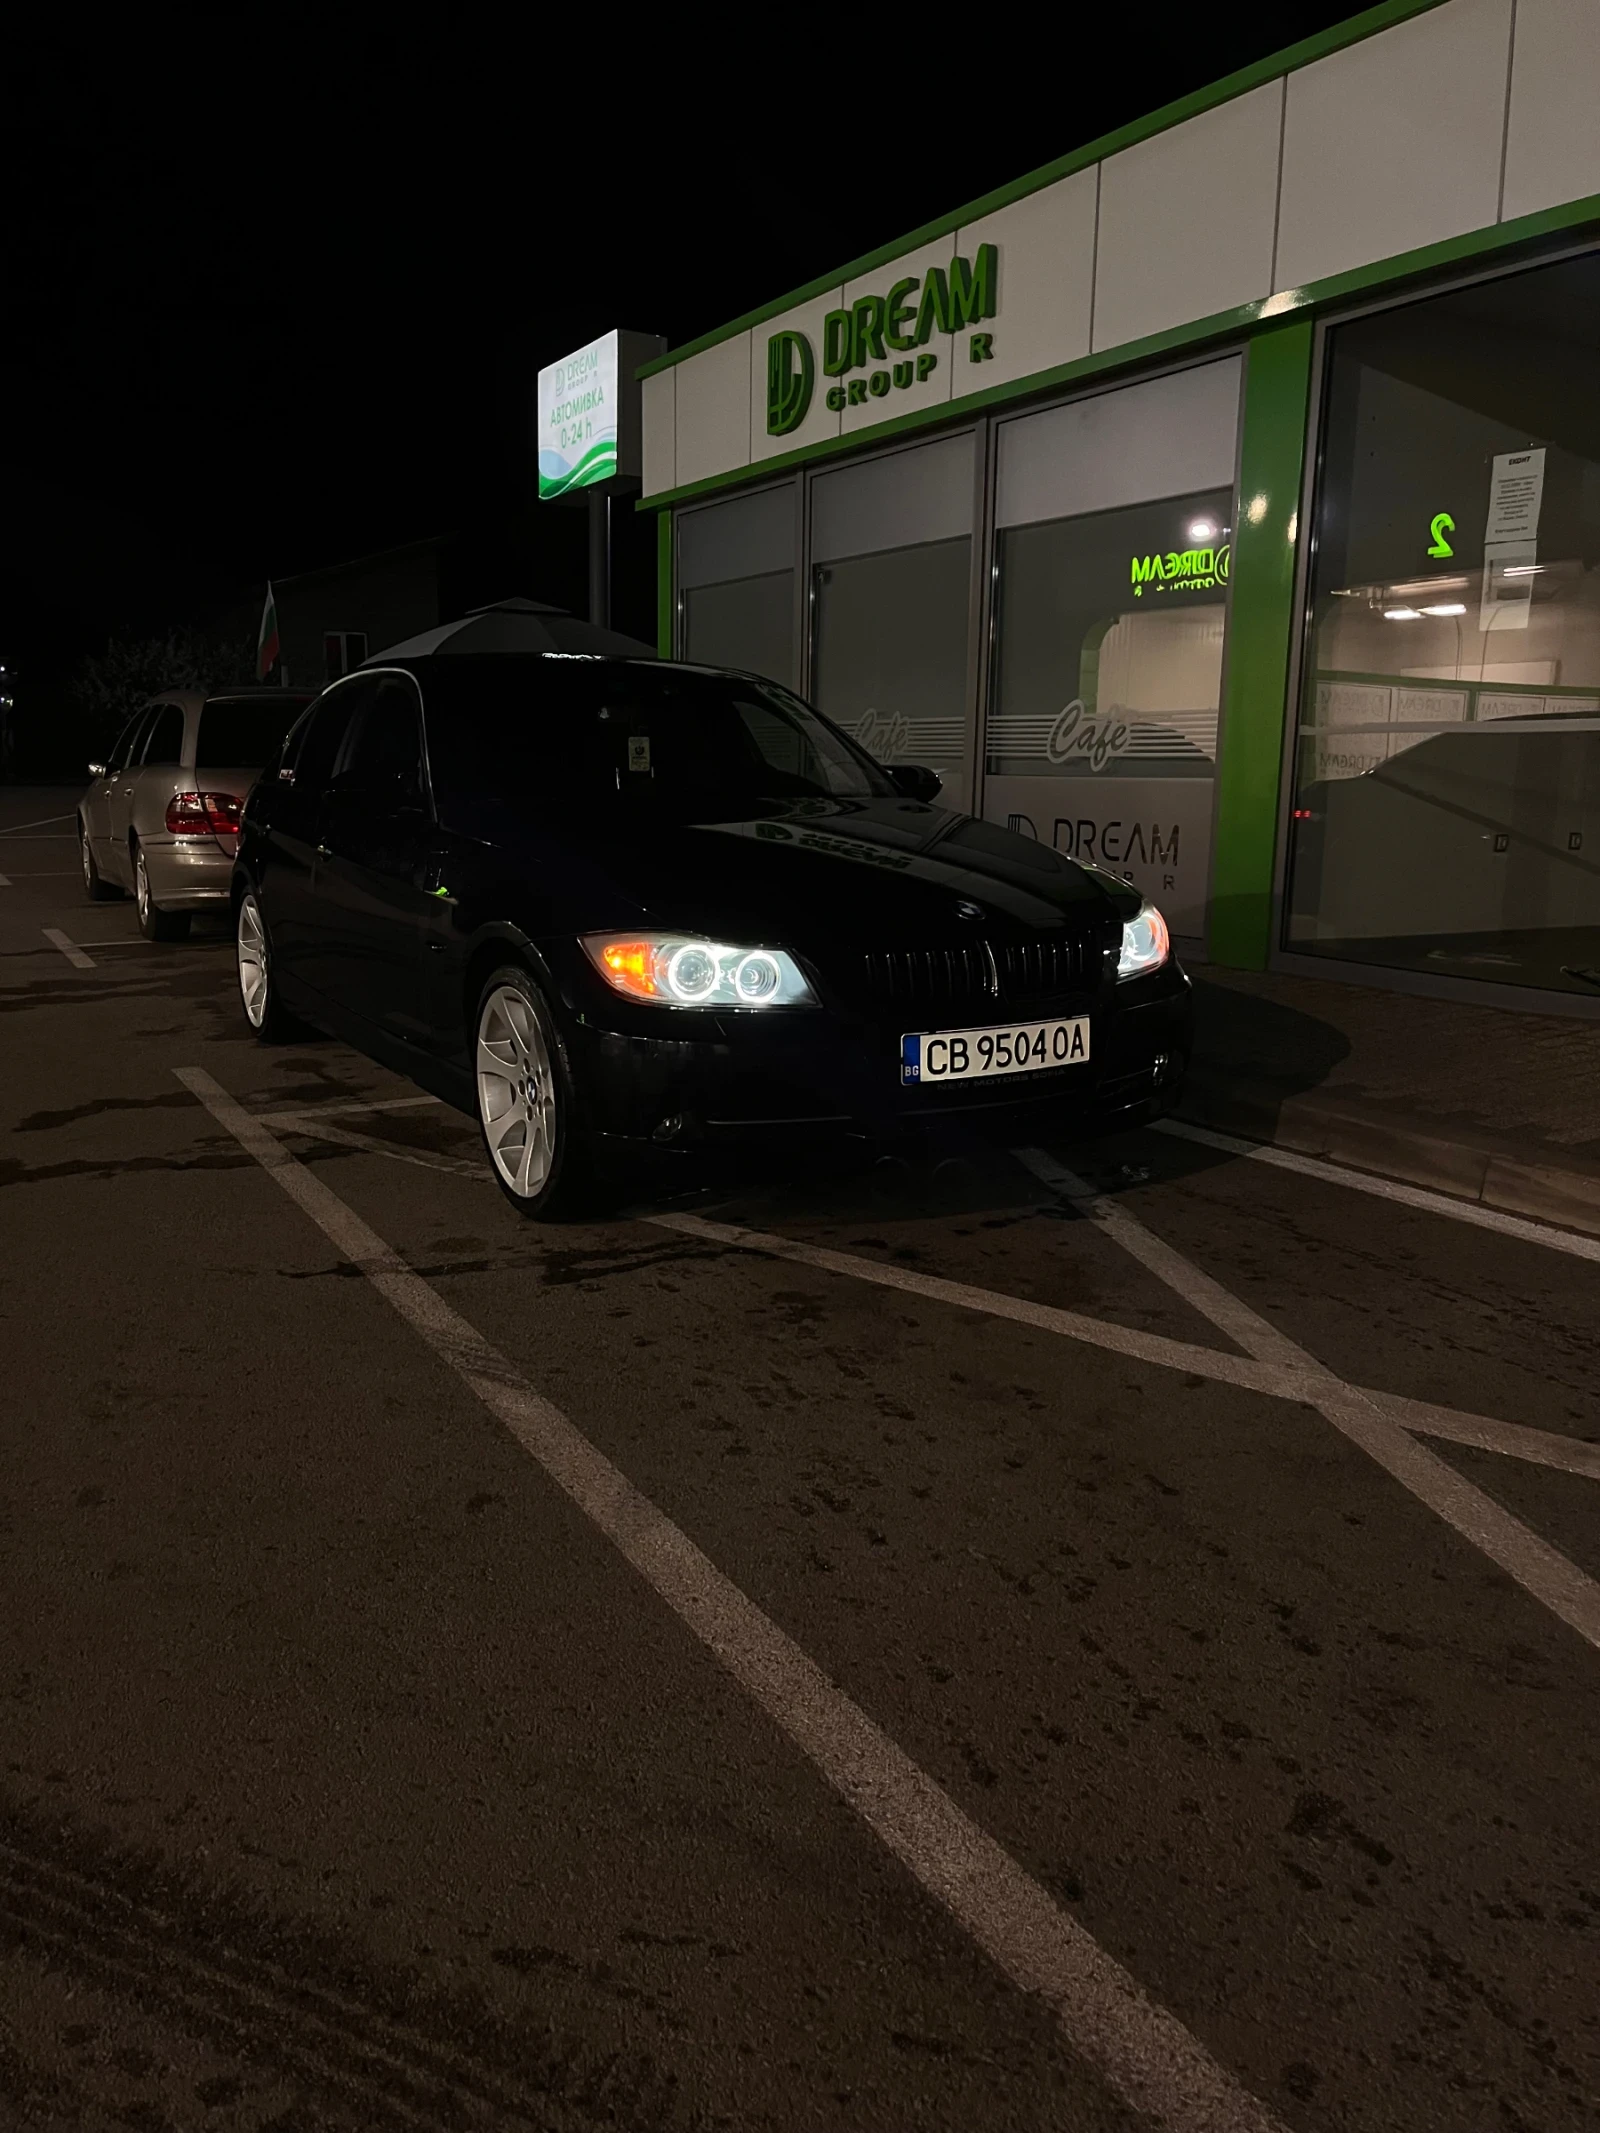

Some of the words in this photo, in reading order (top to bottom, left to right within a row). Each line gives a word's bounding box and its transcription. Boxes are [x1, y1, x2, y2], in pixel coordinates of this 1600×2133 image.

[823, 243, 998, 377] DREAM
[567, 349, 598, 381] DREAM
[826, 353, 938, 412] GROUP
[970, 333, 994, 363] R
[550, 386, 604, 427] АВТОМИВКА
[1053, 818, 1180, 866] DREAM
[1163, 874, 1175, 891] R
[926, 1037, 970, 1075] CB
[977, 1028, 1047, 1071] 9504
[1053, 1023, 1085, 1060] OA
[904, 1065, 920, 1077] BG
[973, 1073, 1029, 1087] MOTORS
